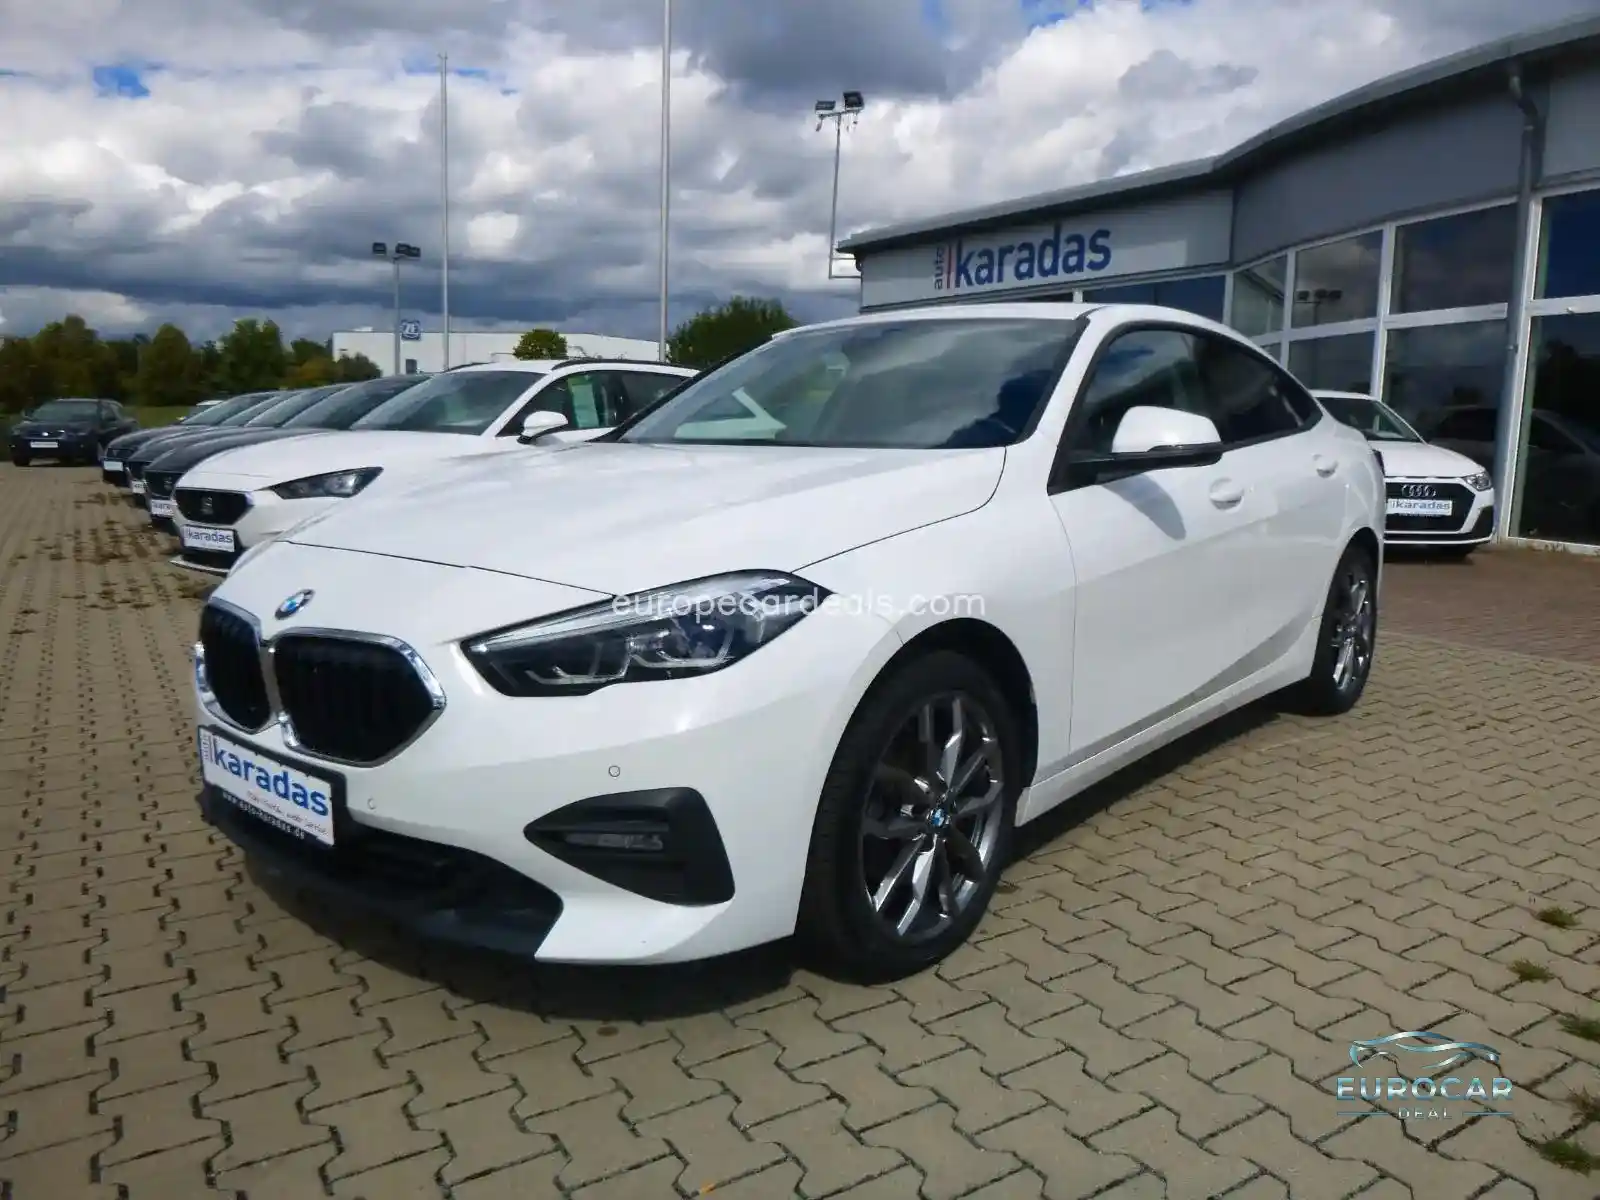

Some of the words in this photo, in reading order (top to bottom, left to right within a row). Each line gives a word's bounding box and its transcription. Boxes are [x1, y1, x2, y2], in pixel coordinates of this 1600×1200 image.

[955, 222, 1112, 288] karadas
[188, 528, 233, 543] karadas
[213, 737, 329, 817] karadas
